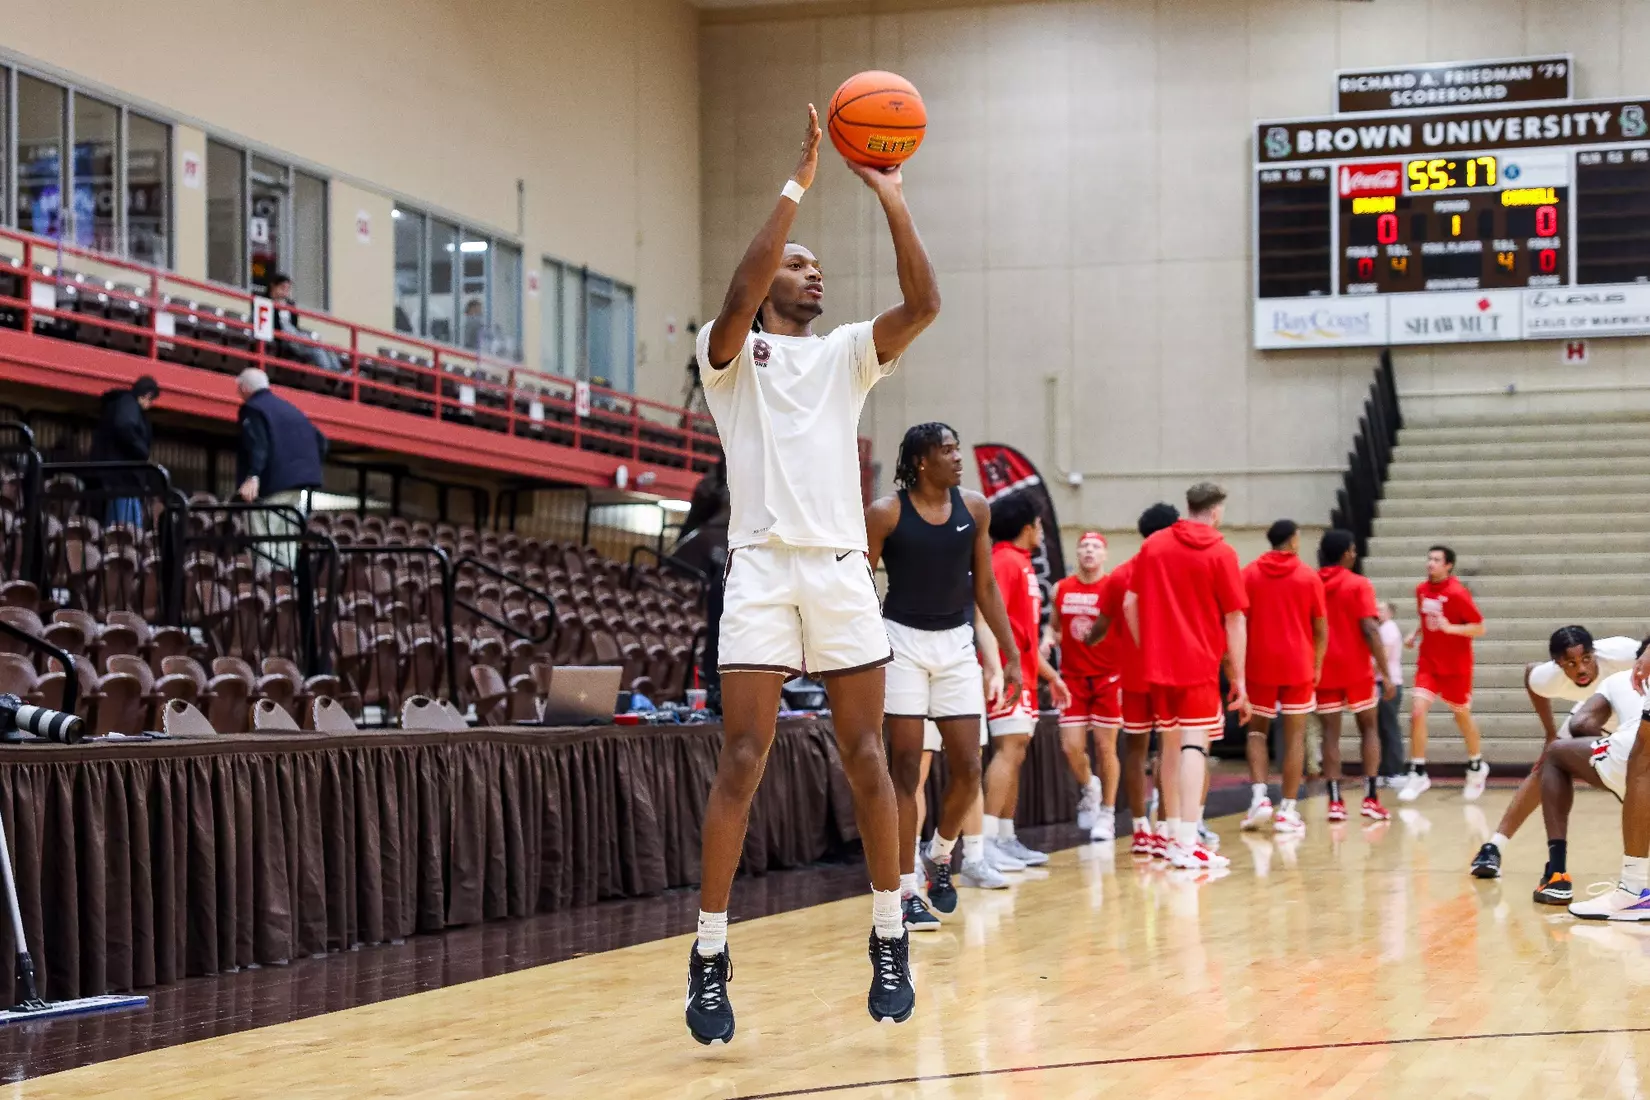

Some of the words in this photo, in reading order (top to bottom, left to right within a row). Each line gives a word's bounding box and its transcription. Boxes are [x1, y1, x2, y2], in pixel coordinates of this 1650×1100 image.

[1339, 73, 1417, 93] RICHARD
[1420, 72, 1439, 88] A.
[1444, 65, 1534, 84] FRIEDMAN
[1390, 84, 1508, 107] SCOREBOARD
[1296, 123, 1413, 153] BROWN
[1422, 110, 1613, 148] UNIVERSITY
[866, 137, 917, 153] ELITE
[1407, 155, 1497, 192] 55:17
[1376, 213, 1398, 244] 0
[1451, 214, 1462, 236] 1
[1536, 205, 1558, 237] 0
[1539, 248, 1557, 273] 0
[259, 305, 269, 331] F
[1405, 315, 1502, 336] SHAWMUT
[1567, 343, 1585, 360] H
